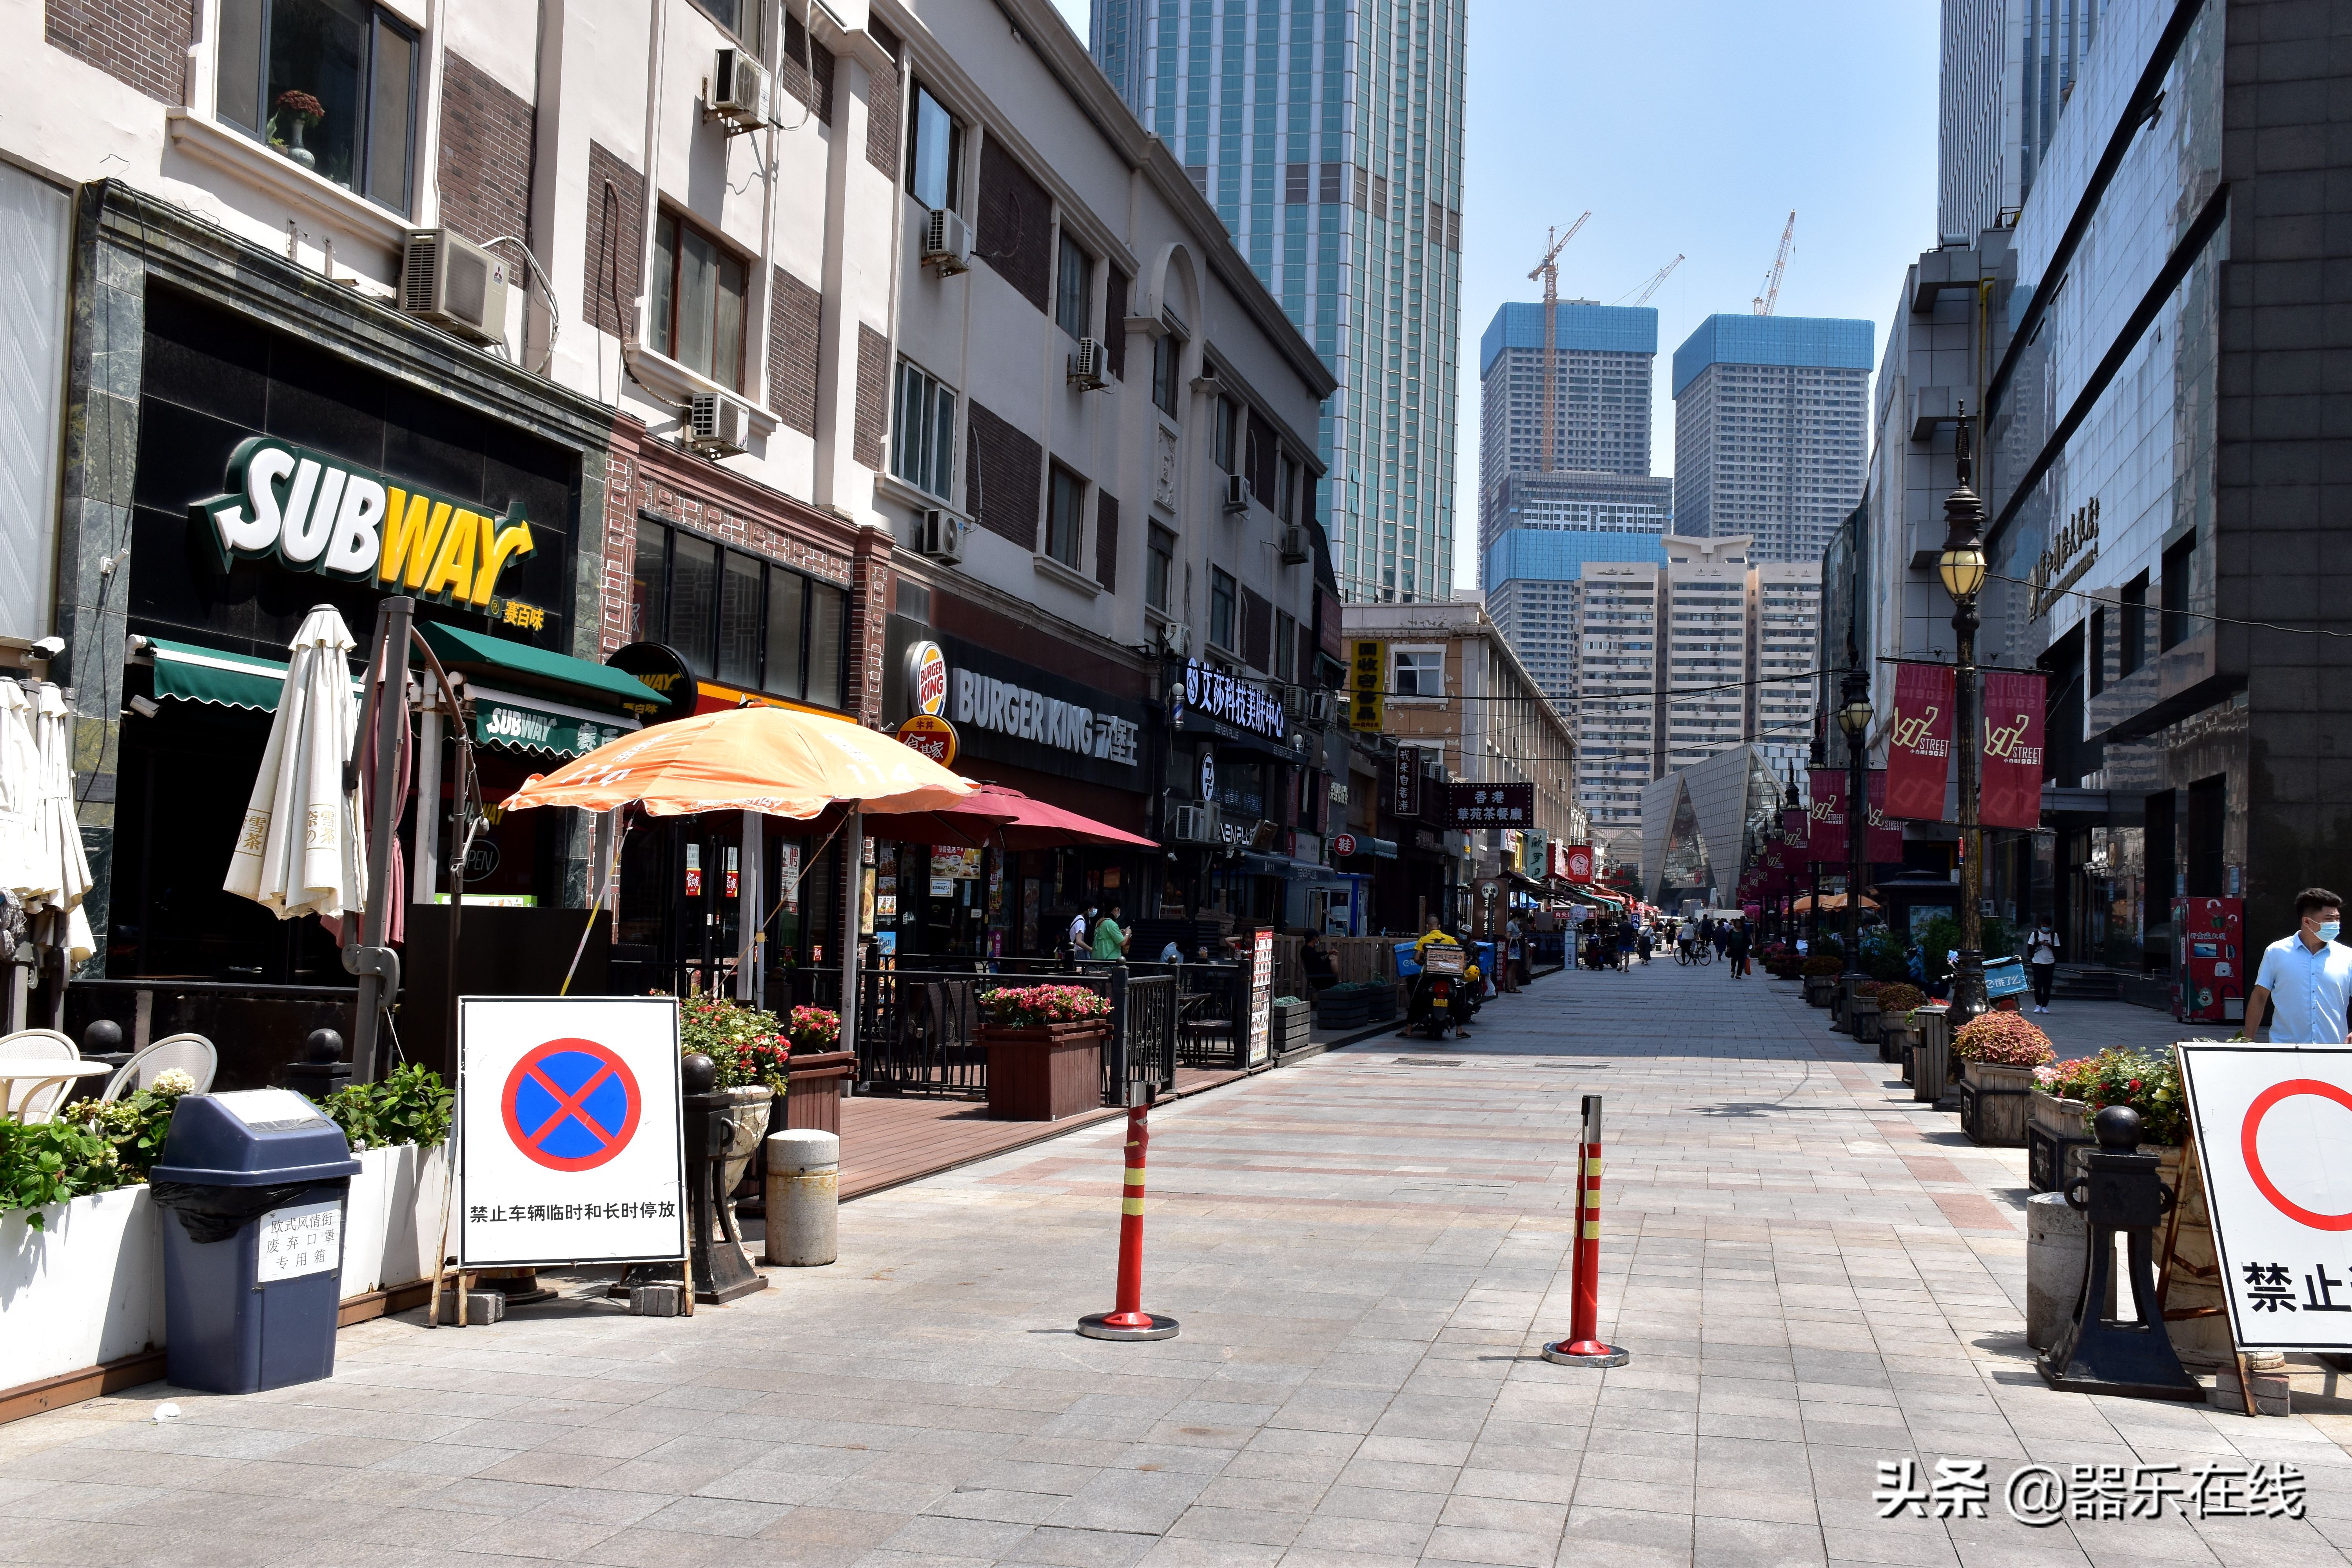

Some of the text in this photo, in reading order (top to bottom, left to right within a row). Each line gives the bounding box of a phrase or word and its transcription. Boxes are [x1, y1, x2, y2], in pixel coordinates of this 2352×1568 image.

[214, 448, 535, 607] SUBWAY
[504, 600, 545, 631] 赛百味
[920, 661, 943, 684] BURGER
[920, 675, 944, 706] KING
[916, 720, 935, 730] 牛丼
[952, 668, 1139, 767] BURGER KING 汉堡王
[486, 707, 558, 742] SUBWAY
[577, 722, 622, 751] 赛百
[1920, 738, 1950, 757] STREET
[2013, 747, 2042, 765] STREET
[559, 763, 634, 787] 114
[846, 762, 915, 784] 114
[1397, 750, 1411, 812] 我来自香港
[1474, 790, 1504, 804] 香港
[1457, 807, 1523, 821] 華苑茶餐廳
[1827, 813, 1844, 825] STREET
[1885, 820, 1902, 831] STREET
[1337, 837, 1352, 851] 鞋
[466, 850, 494, 871] PEN
[789, 847, 798, 868] 聘
[1995, 975, 2021, 987] 饿了么
[271, 1212, 333, 1234] 欧式风情街
[470, 1201, 675, 1223] 禁止车辆临时和长时停放
[267, 1229, 335, 1253] 废弃口罩
[276, 1249, 326, 1270] 专用箱
[2243, 1261, 2352, 1313] 禁止
